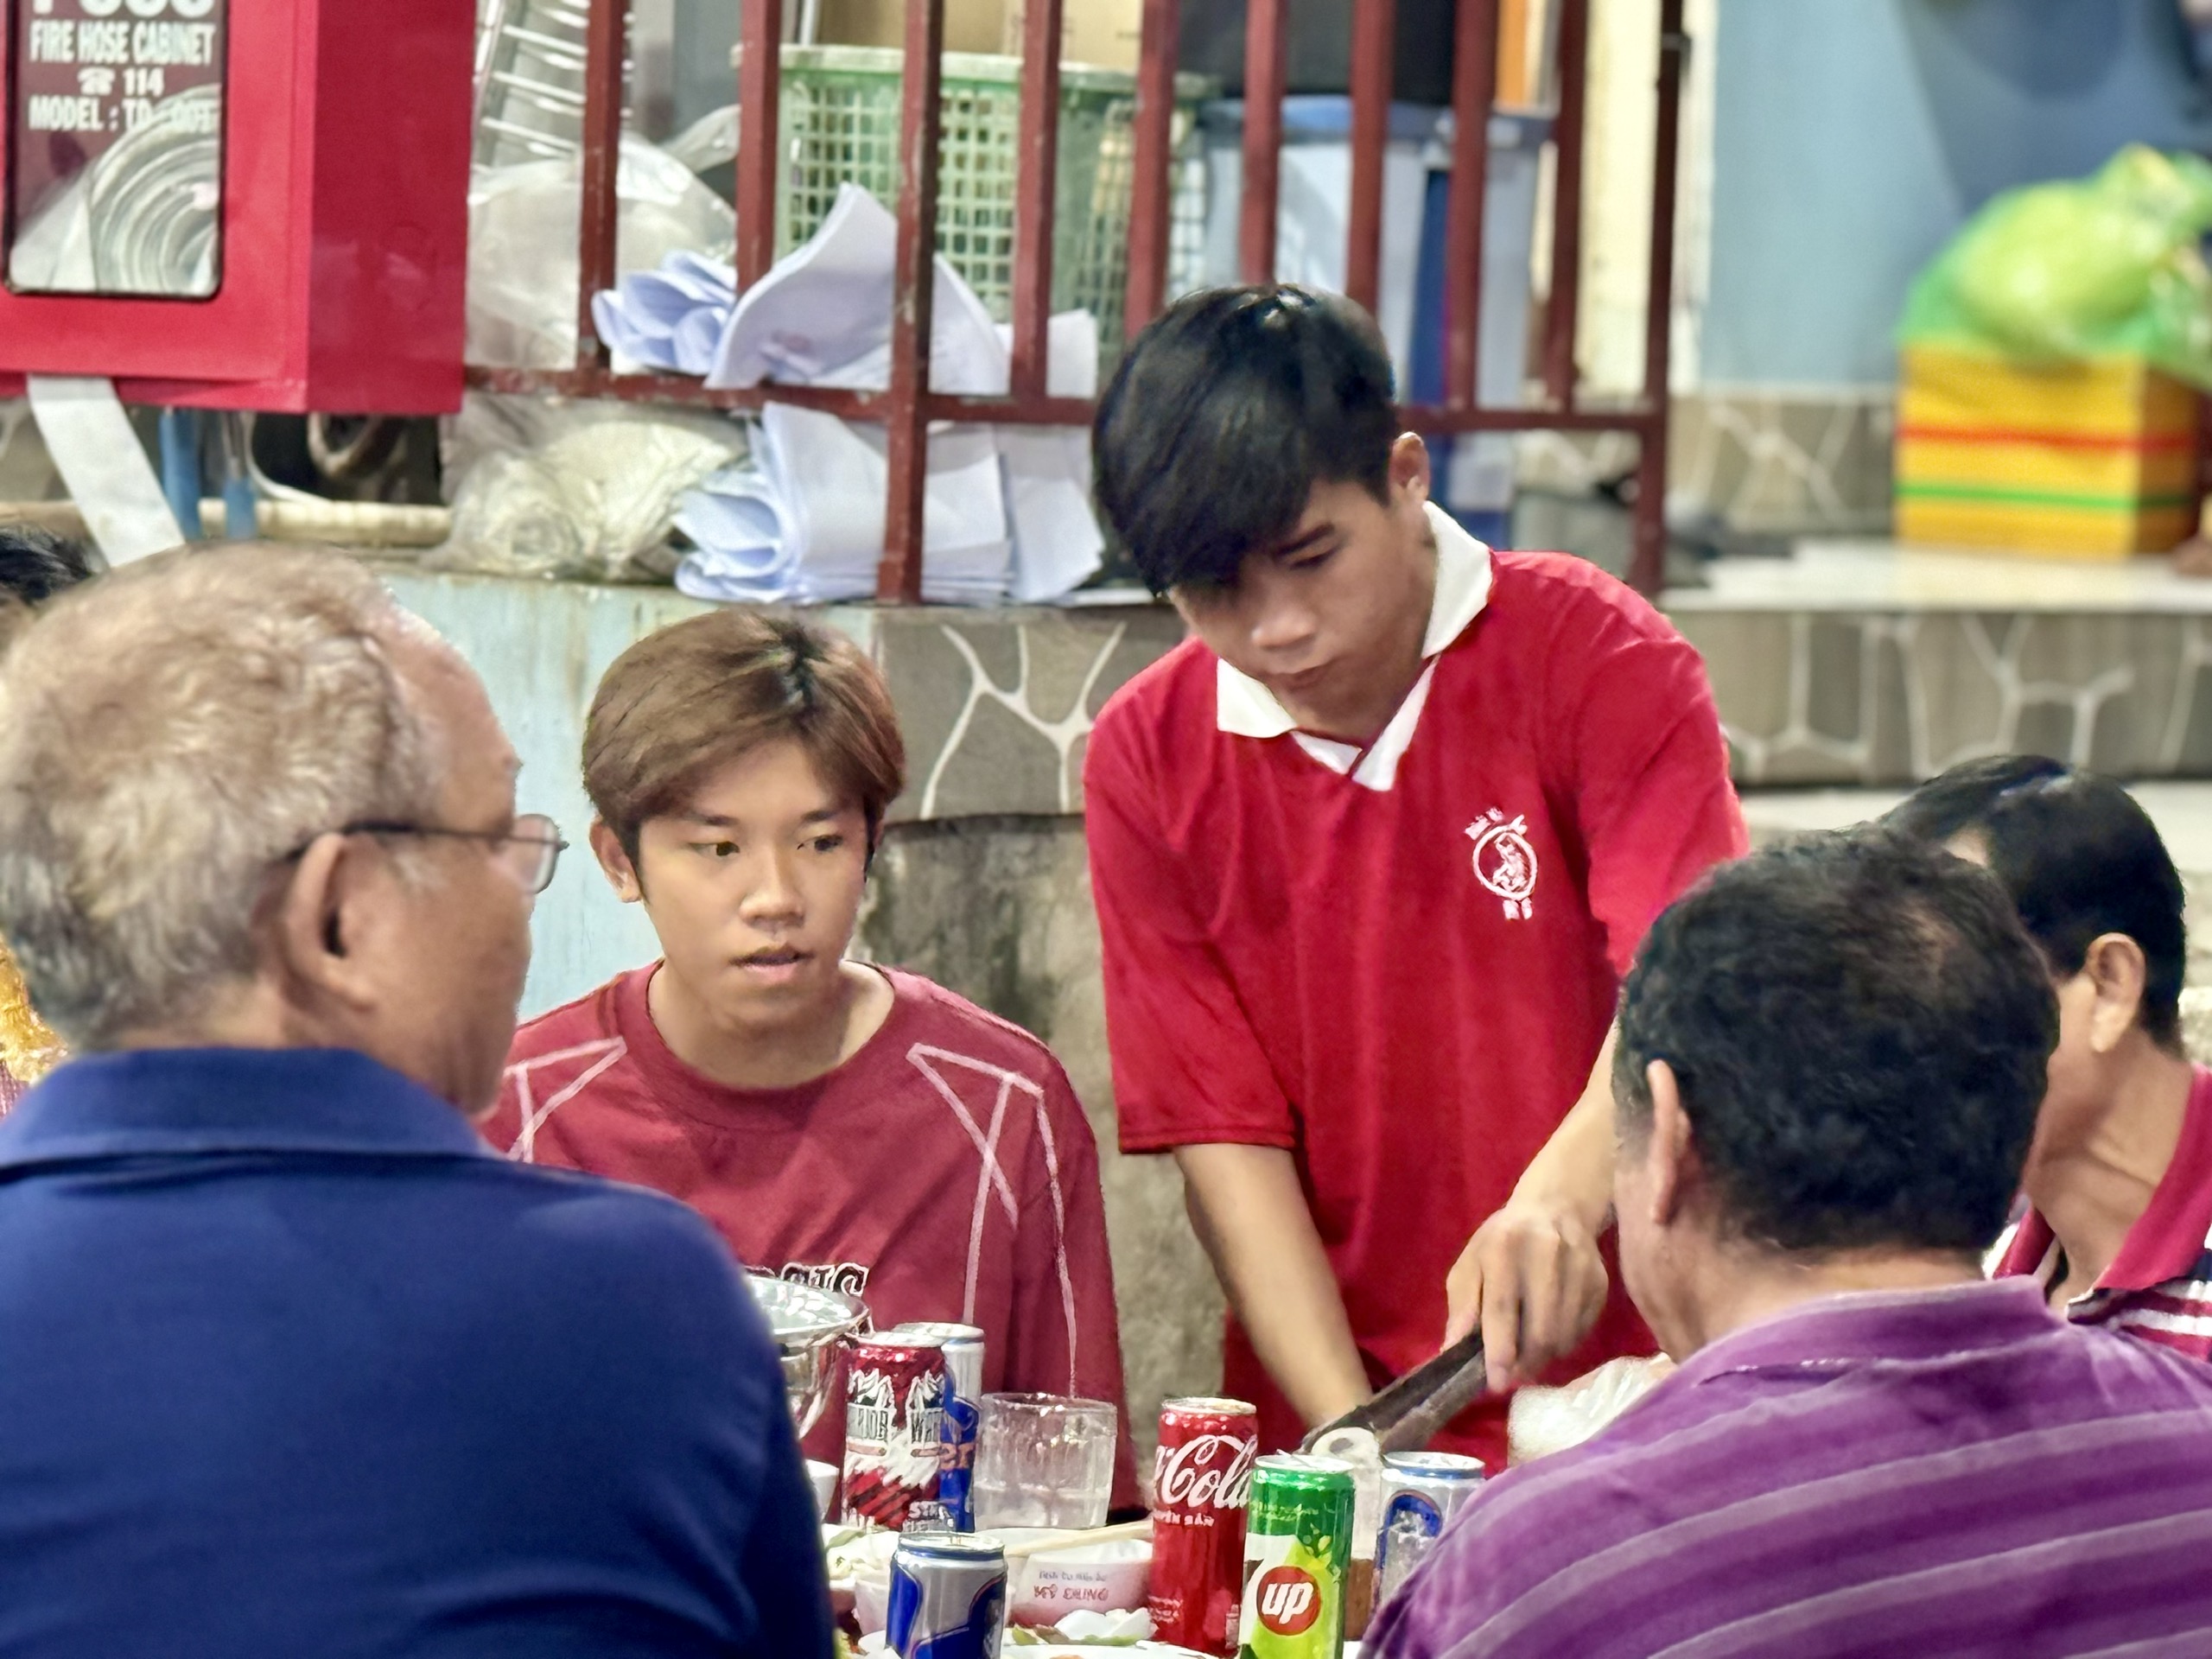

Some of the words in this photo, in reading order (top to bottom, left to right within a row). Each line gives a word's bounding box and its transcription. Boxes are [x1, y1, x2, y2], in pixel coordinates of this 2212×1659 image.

[30, 20, 75, 63] FIRE
[78, 21, 130, 65] HOSE
[132, 22, 216, 67] CABINET
[123, 67, 165, 97] 114
[29, 95, 105, 131] MODEL
